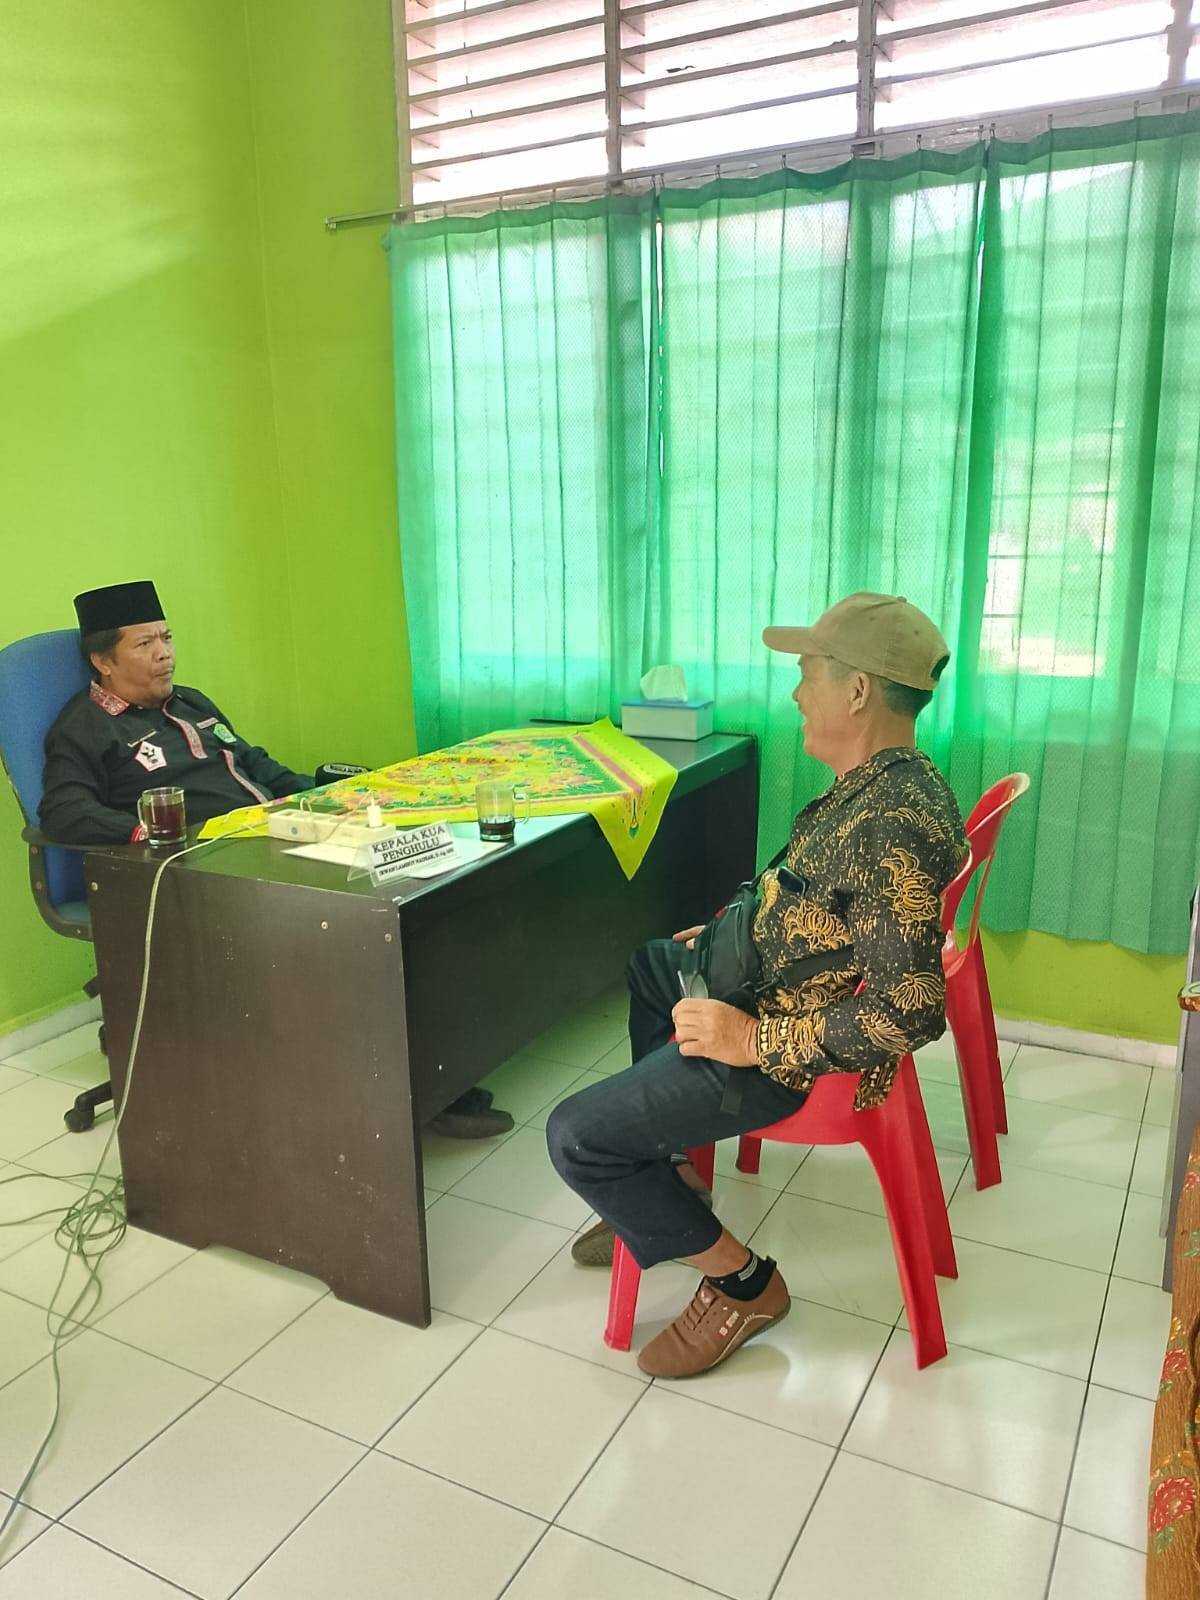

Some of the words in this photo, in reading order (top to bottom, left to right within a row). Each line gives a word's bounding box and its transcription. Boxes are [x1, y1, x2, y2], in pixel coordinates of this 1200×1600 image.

[371, 834, 419, 854] KEPALA
[420, 825, 446, 840] KUA
[382, 837, 440, 862] PENGHULU
